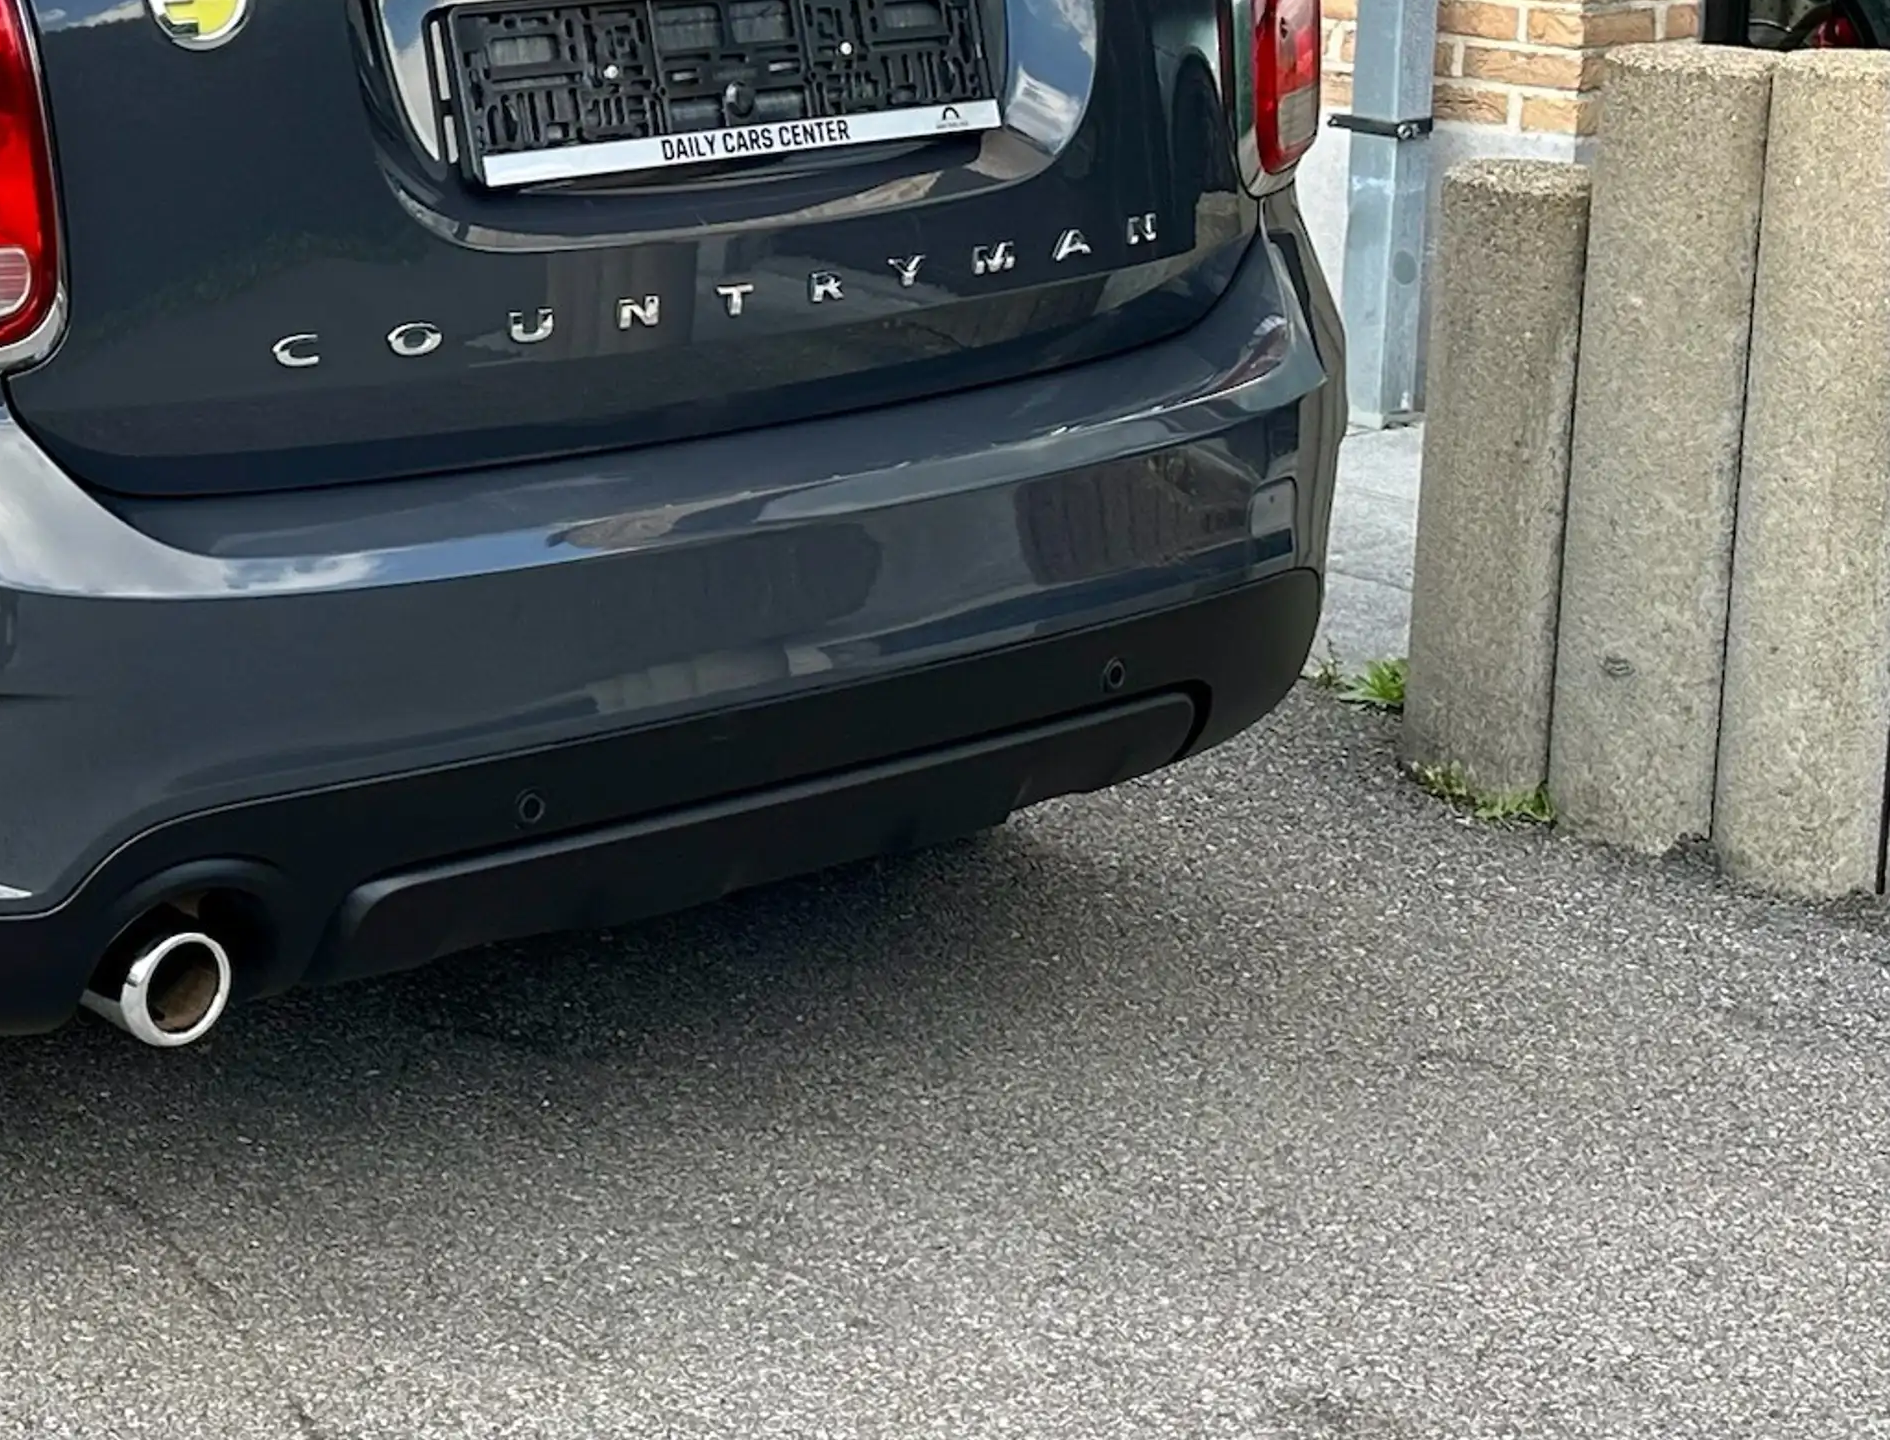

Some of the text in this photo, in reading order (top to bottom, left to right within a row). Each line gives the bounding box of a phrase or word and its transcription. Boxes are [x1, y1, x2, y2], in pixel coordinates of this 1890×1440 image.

[661, 119, 851, 161] DAILY CARS CENTER
[272, 213, 1158, 368] COUNTRYMAN
